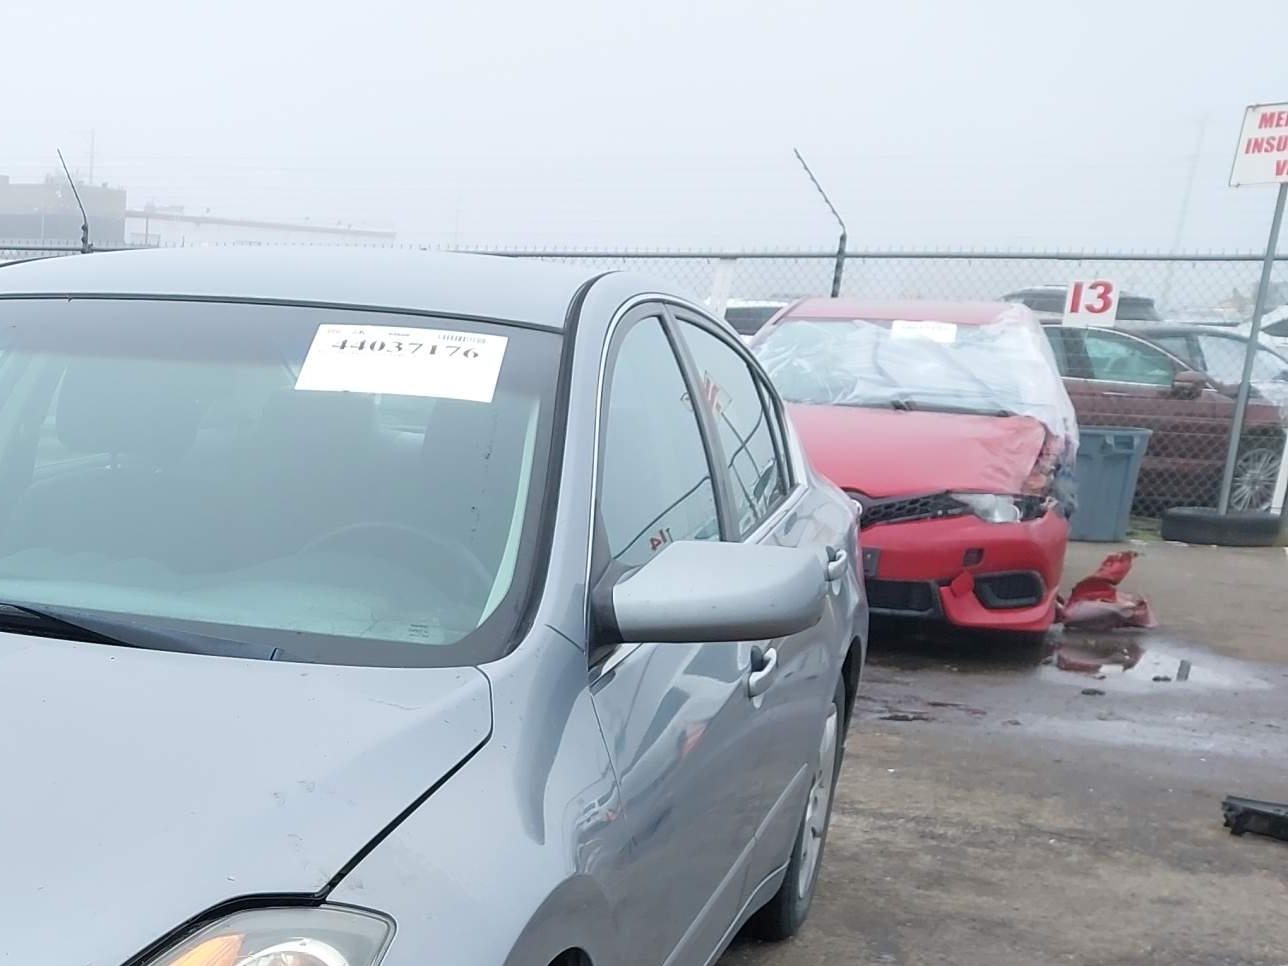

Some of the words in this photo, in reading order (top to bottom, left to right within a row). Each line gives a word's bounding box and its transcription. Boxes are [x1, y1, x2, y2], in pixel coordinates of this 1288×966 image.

[1258, 110, 1288, 129] ME
[1275, 159, 1288, 176] V
[1070, 281, 1113, 313] 13
[331, 338, 480, 359] 44037176
